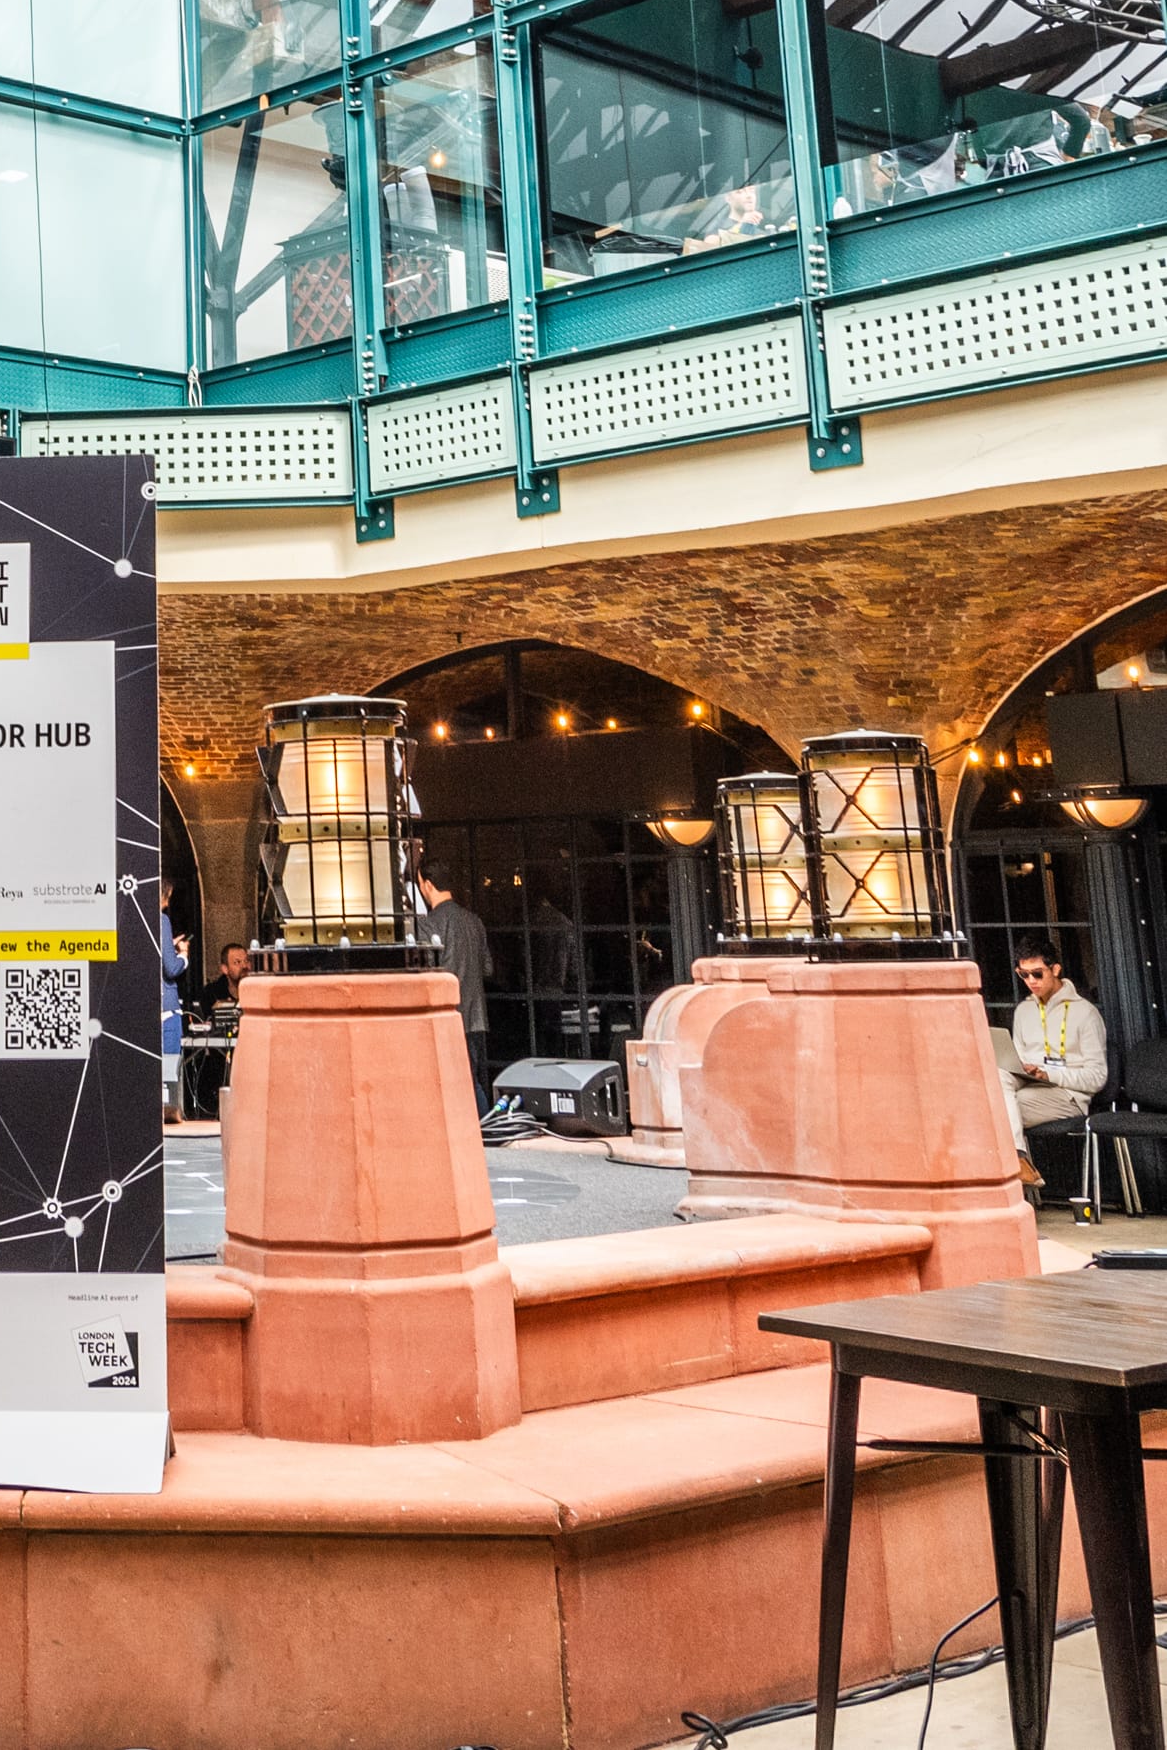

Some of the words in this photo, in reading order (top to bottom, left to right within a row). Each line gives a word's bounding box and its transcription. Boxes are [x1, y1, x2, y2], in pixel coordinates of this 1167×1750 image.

[34, 722, 92, 748] HUB
[33, 883, 93, 897] substrate
[94, 882, 107, 895] AI
[26, 940, 51, 952] the
[59, 939, 110, 955] Agenda
[68, 1294, 99, 1302] Headline
[130, 1294, 139, 1302] of
[78, 1332, 115, 1340] LONDON
[79, 1341, 116, 1354] TECH
[88, 1355, 129, 1367] WEEK
[112, 1375, 138, 1386] 2024
